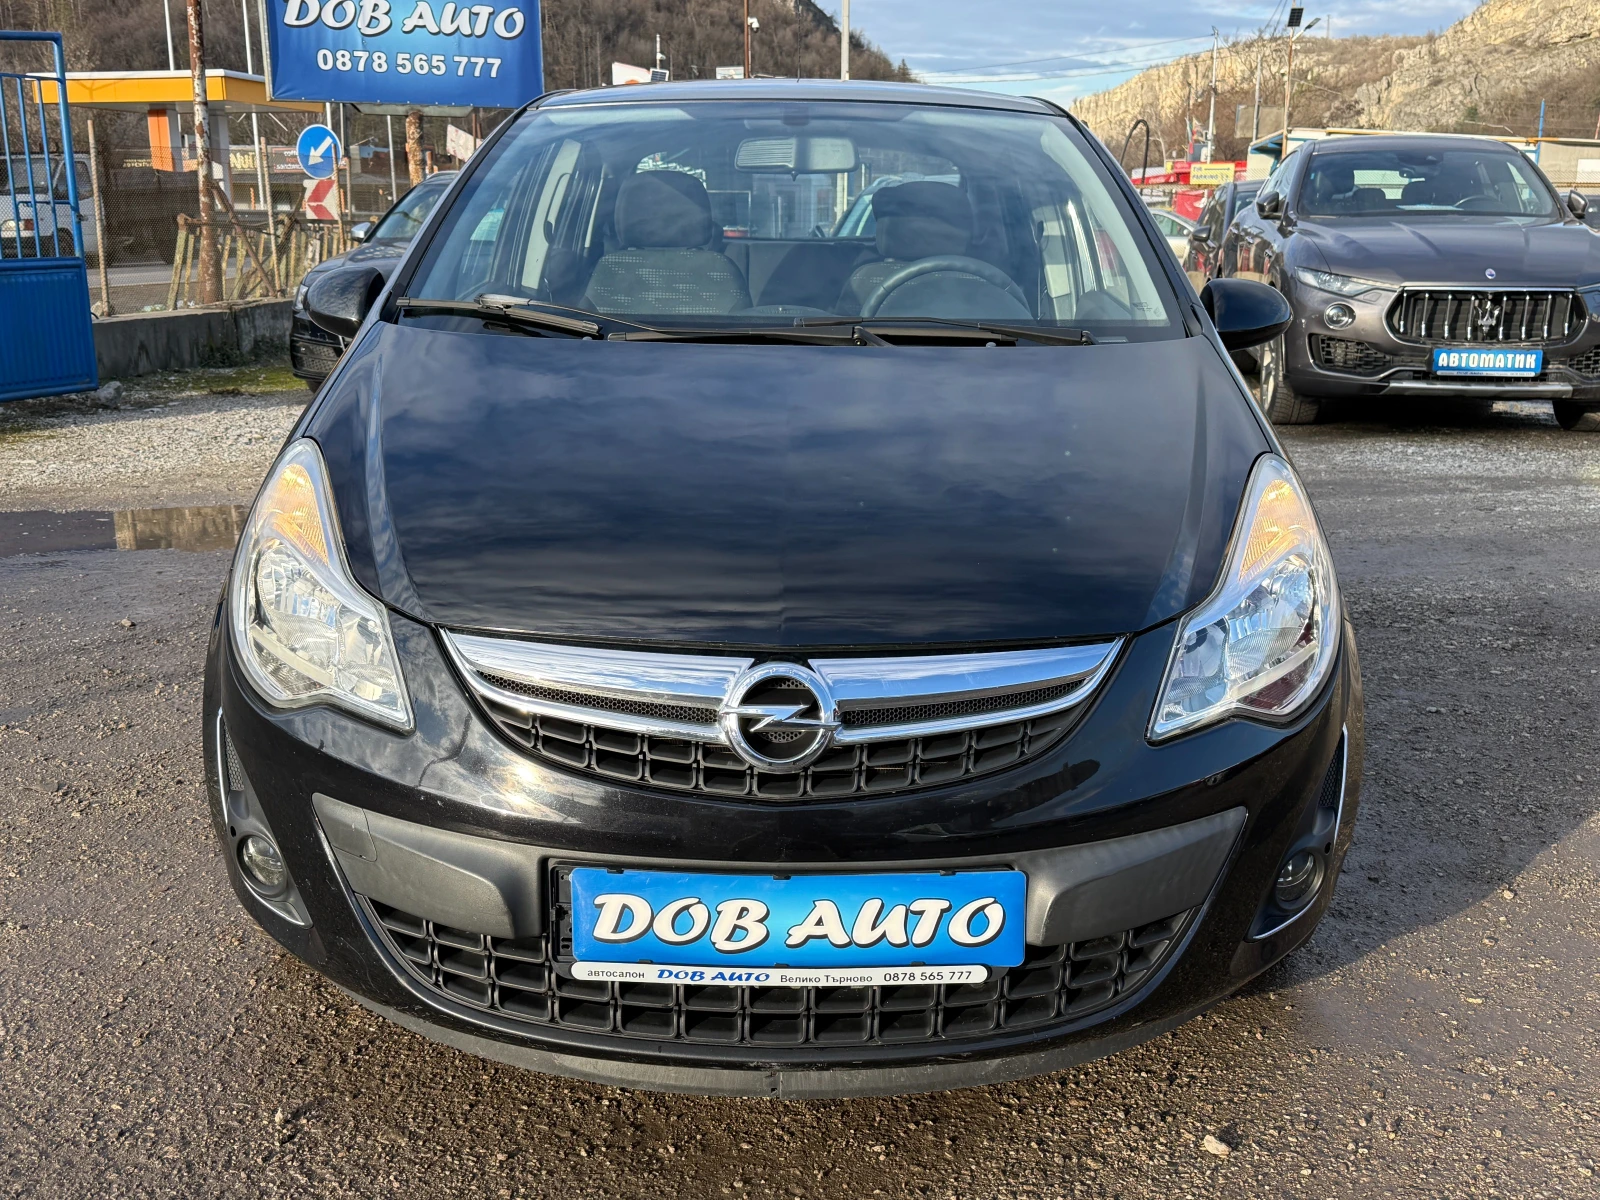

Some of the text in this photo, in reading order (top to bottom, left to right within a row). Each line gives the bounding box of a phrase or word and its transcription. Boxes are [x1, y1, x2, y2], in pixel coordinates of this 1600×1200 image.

[283, 0, 525, 40] DOB AUTO
[317, 48, 502, 78] 0878 565 777
[1438, 352, 1537, 369] АВТОМАТИК
[592, 893, 1007, 954] DOB AUTO
[587, 969, 972, 984] автосалон DOB AUTO Велико Търново 0878 565 777
